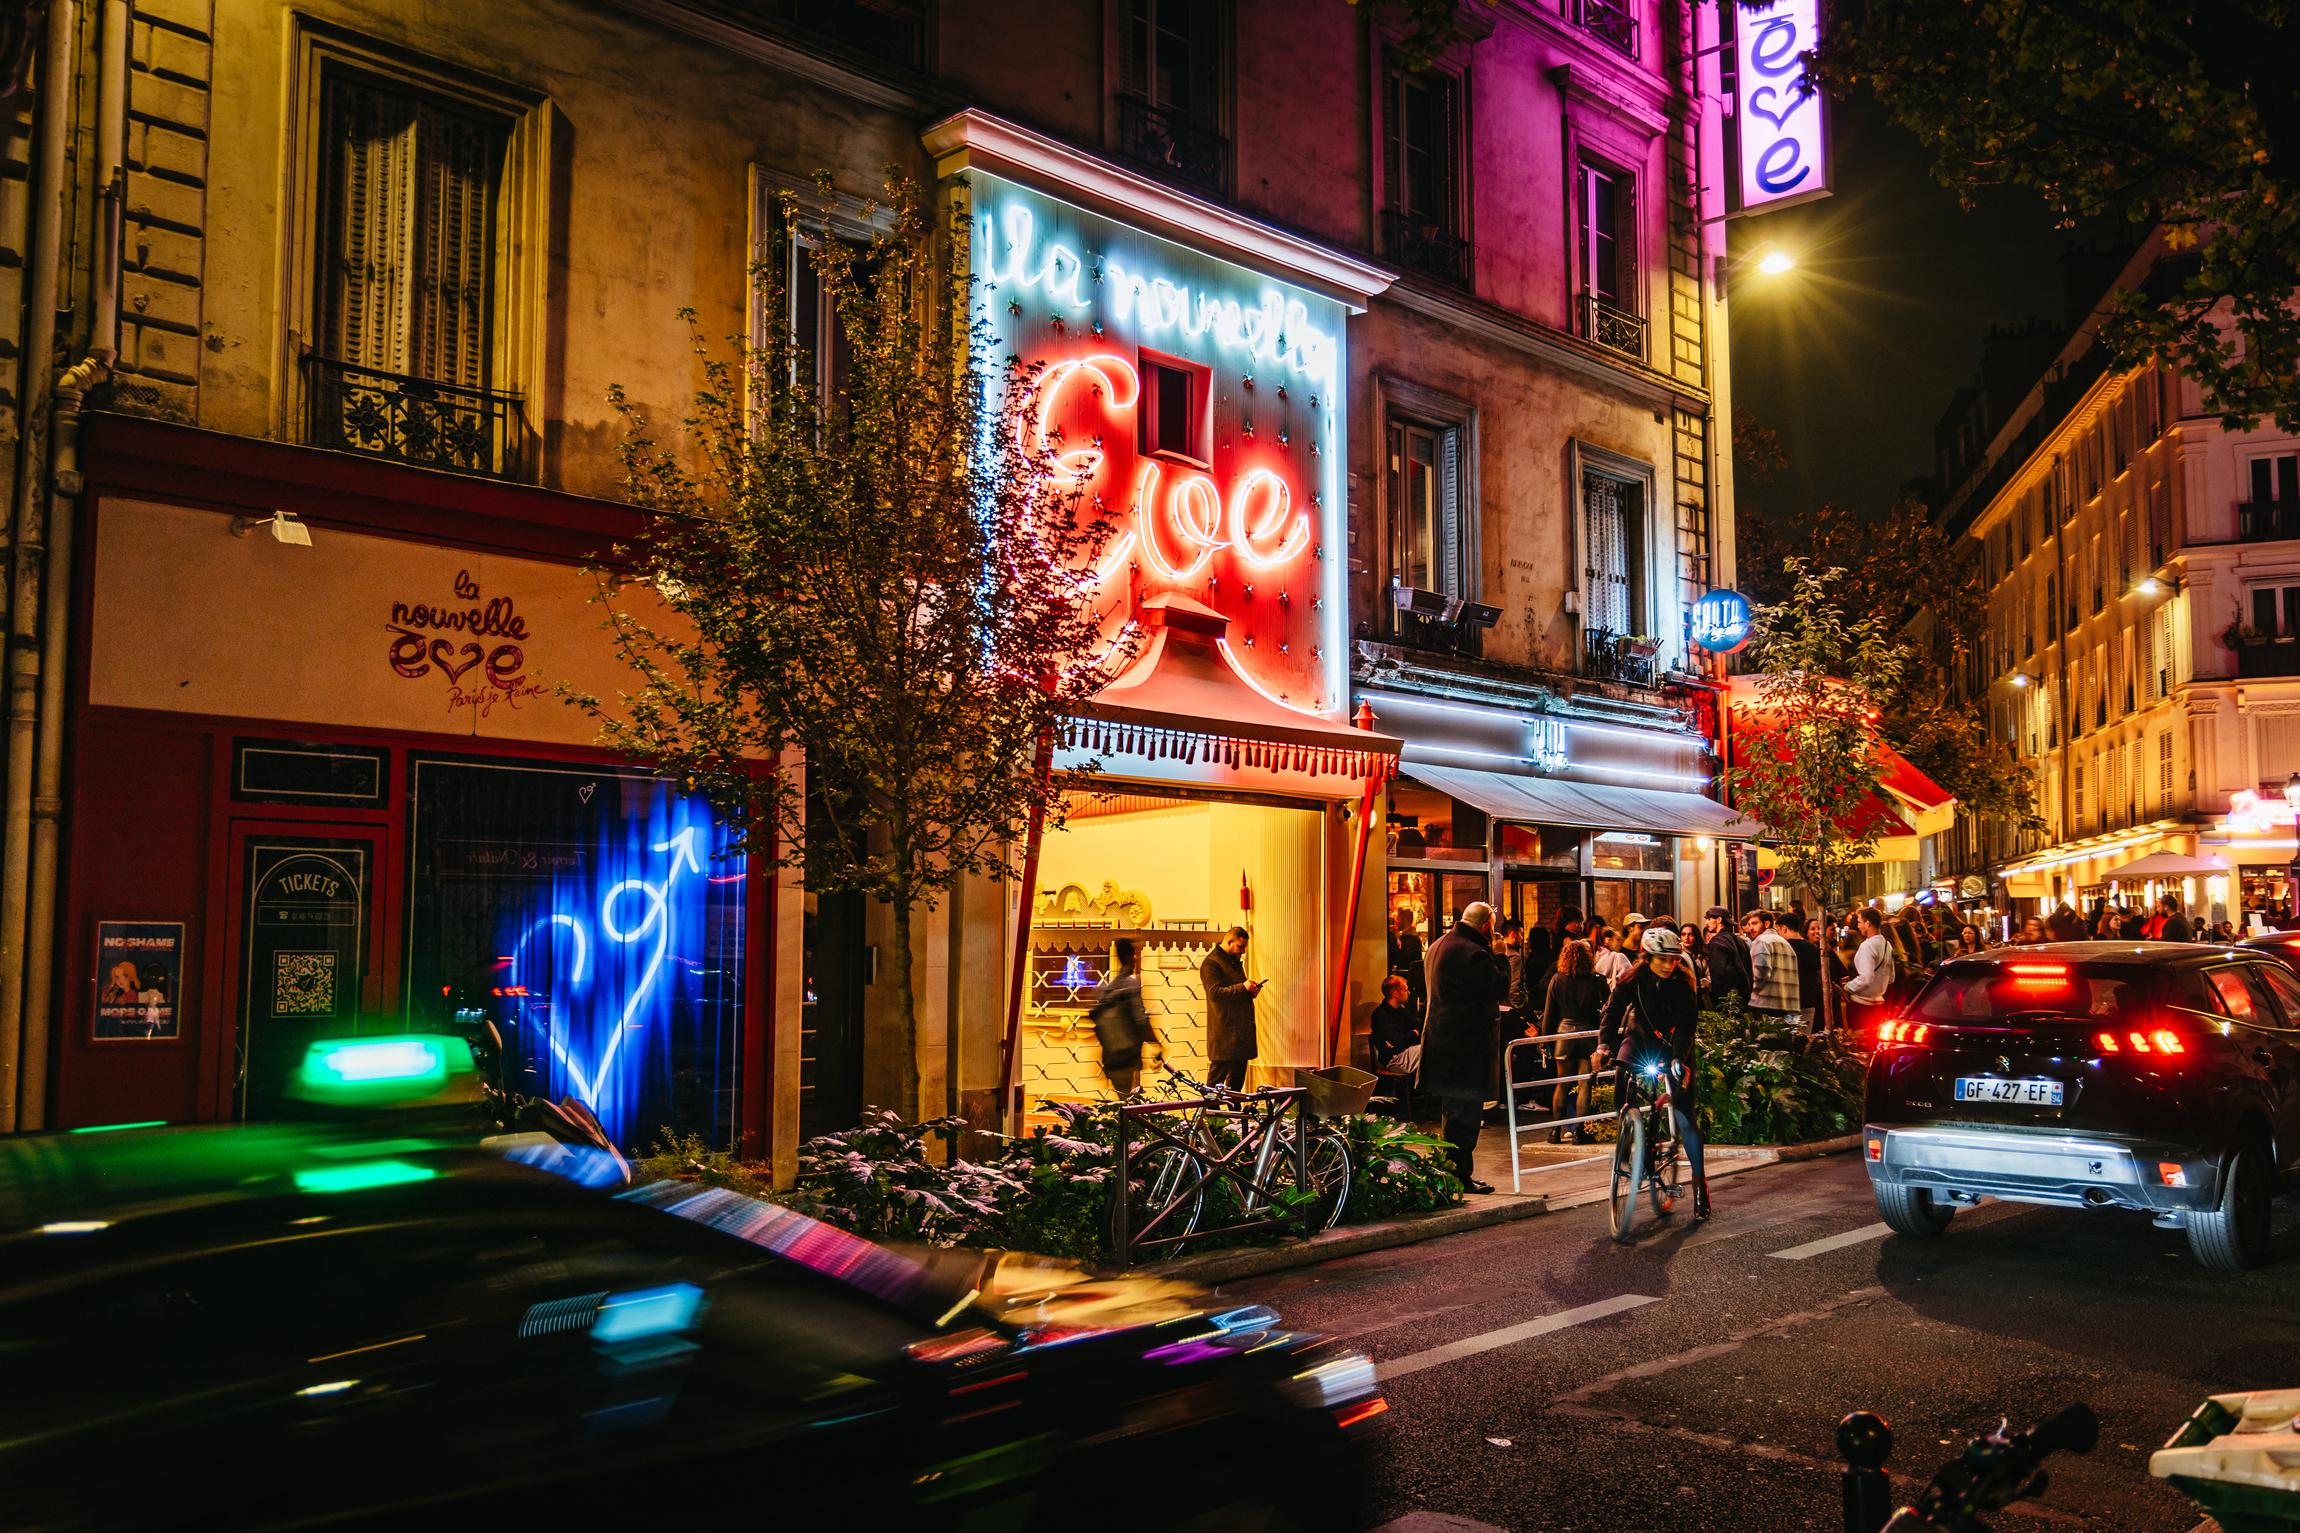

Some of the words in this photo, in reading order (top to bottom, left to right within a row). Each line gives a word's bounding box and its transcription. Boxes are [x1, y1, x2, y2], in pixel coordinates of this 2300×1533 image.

[453, 569, 481, 600] la
[391, 596, 531, 641] nouvelle
[278, 873, 340, 897] TICKETS
[125, 937, 175, 948] SHAME
